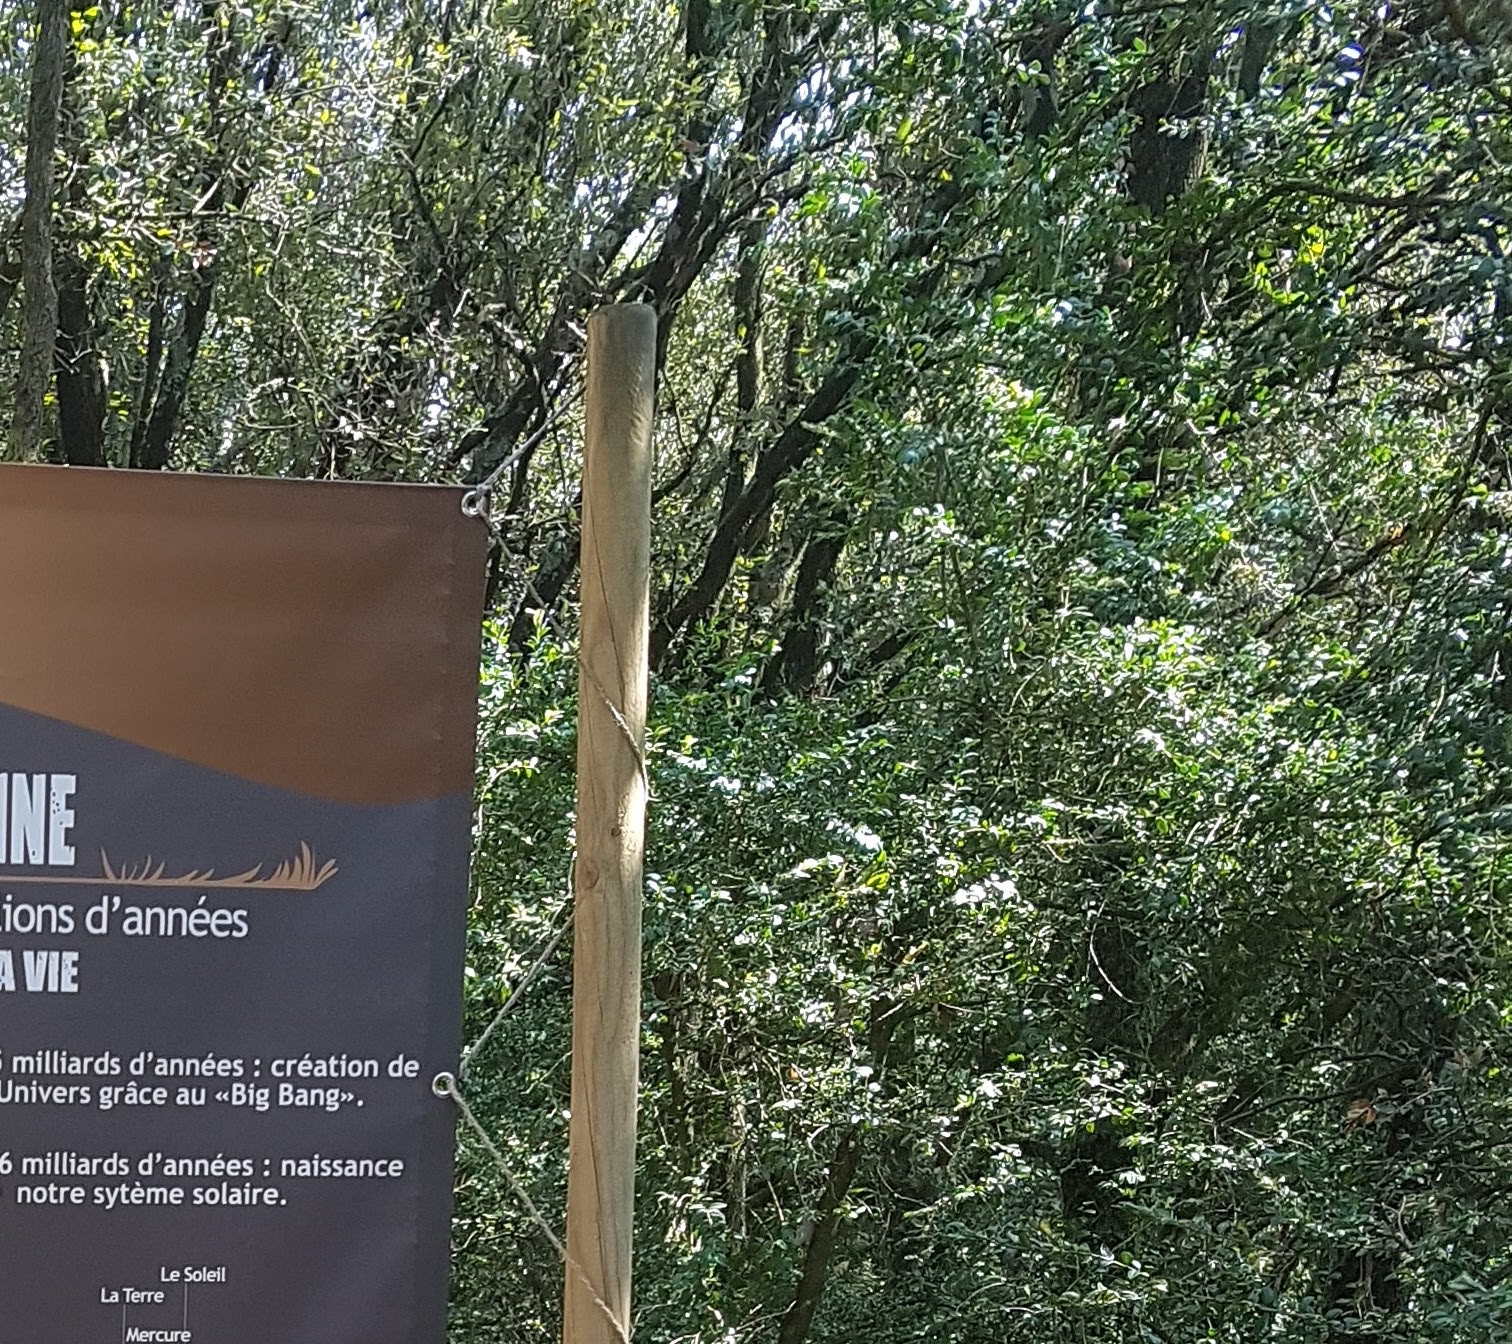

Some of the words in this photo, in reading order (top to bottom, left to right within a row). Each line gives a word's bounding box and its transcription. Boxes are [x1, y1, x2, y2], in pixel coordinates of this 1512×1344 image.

[85, 895, 249, 938] d'années
[22, 950, 79, 993] VIE
[12, 1050, 121, 1075] milliards
[129, 1051, 244, 1077] d'années
[270, 1053, 379, 1078] création
[387, 1053, 420, 1078] de
[99, 1080, 168, 1110] grâce
[175, 1087, 206, 1106] au
[215, 1082, 270, 1112] «Big
[278, 1082, 364, 1112] Bang».
[21, 1151, 130, 1176] milliards
[137, 1152, 254, 1177] d'années
[280, 1153, 404, 1177] naissance
[17, 1182, 86, 1204] notre
[93, 1181, 185, 1210] sytème
[192, 1181, 287, 1206] solaire.
[160, 1266, 181, 1282] Le
[183, 1266, 226, 1282] Soleil
[100, 1287, 120, 1303] La
[121, 1287, 165, 1304] Terre
[125, 1327, 192, 1343] Mercure
